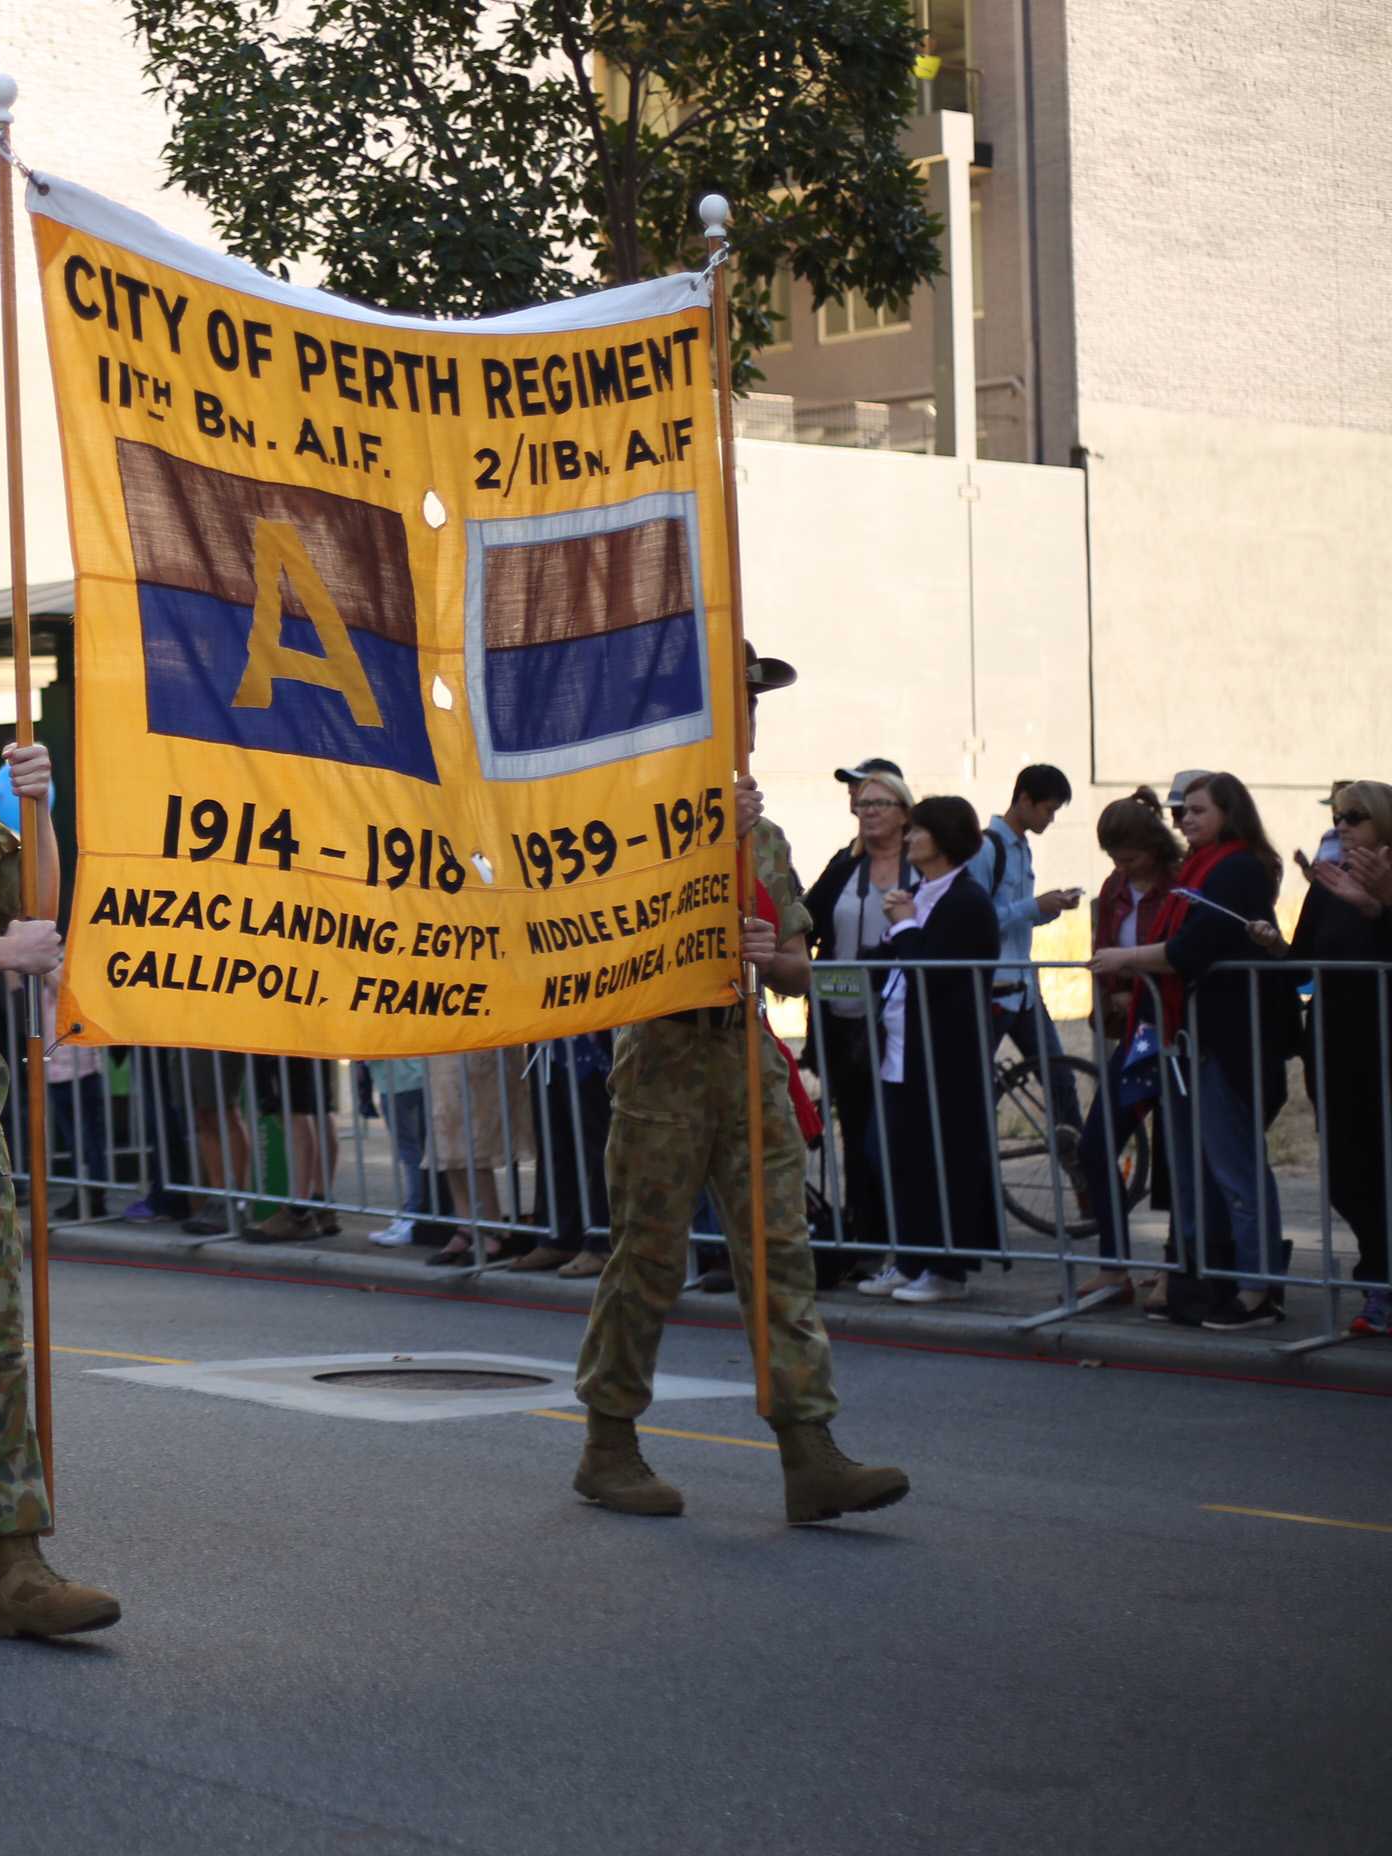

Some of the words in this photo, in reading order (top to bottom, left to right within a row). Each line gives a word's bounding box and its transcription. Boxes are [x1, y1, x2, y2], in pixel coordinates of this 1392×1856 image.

[64, 255, 188, 354] CITY
[207, 309, 273, 378] OF
[294, 330, 460, 417] PERTH
[481, 327, 699, 419] REGIMENT
[294, 418, 391, 479] A.I.F.
[231, 516, 384, 728] A
[162, 793, 300, 871] 1914
[366, 824, 465, 894] 1918
[511, 819, 618, 891] 1939
[89, 886, 232, 931] ANZAC
[239, 896, 408, 956] LANDING,
[677, 872, 730, 916] GREECE
[349, 975, 491, 1017] FRANCE.
[540, 970, 592, 1010] NEW
[675, 926, 737, 969] CRETE.
